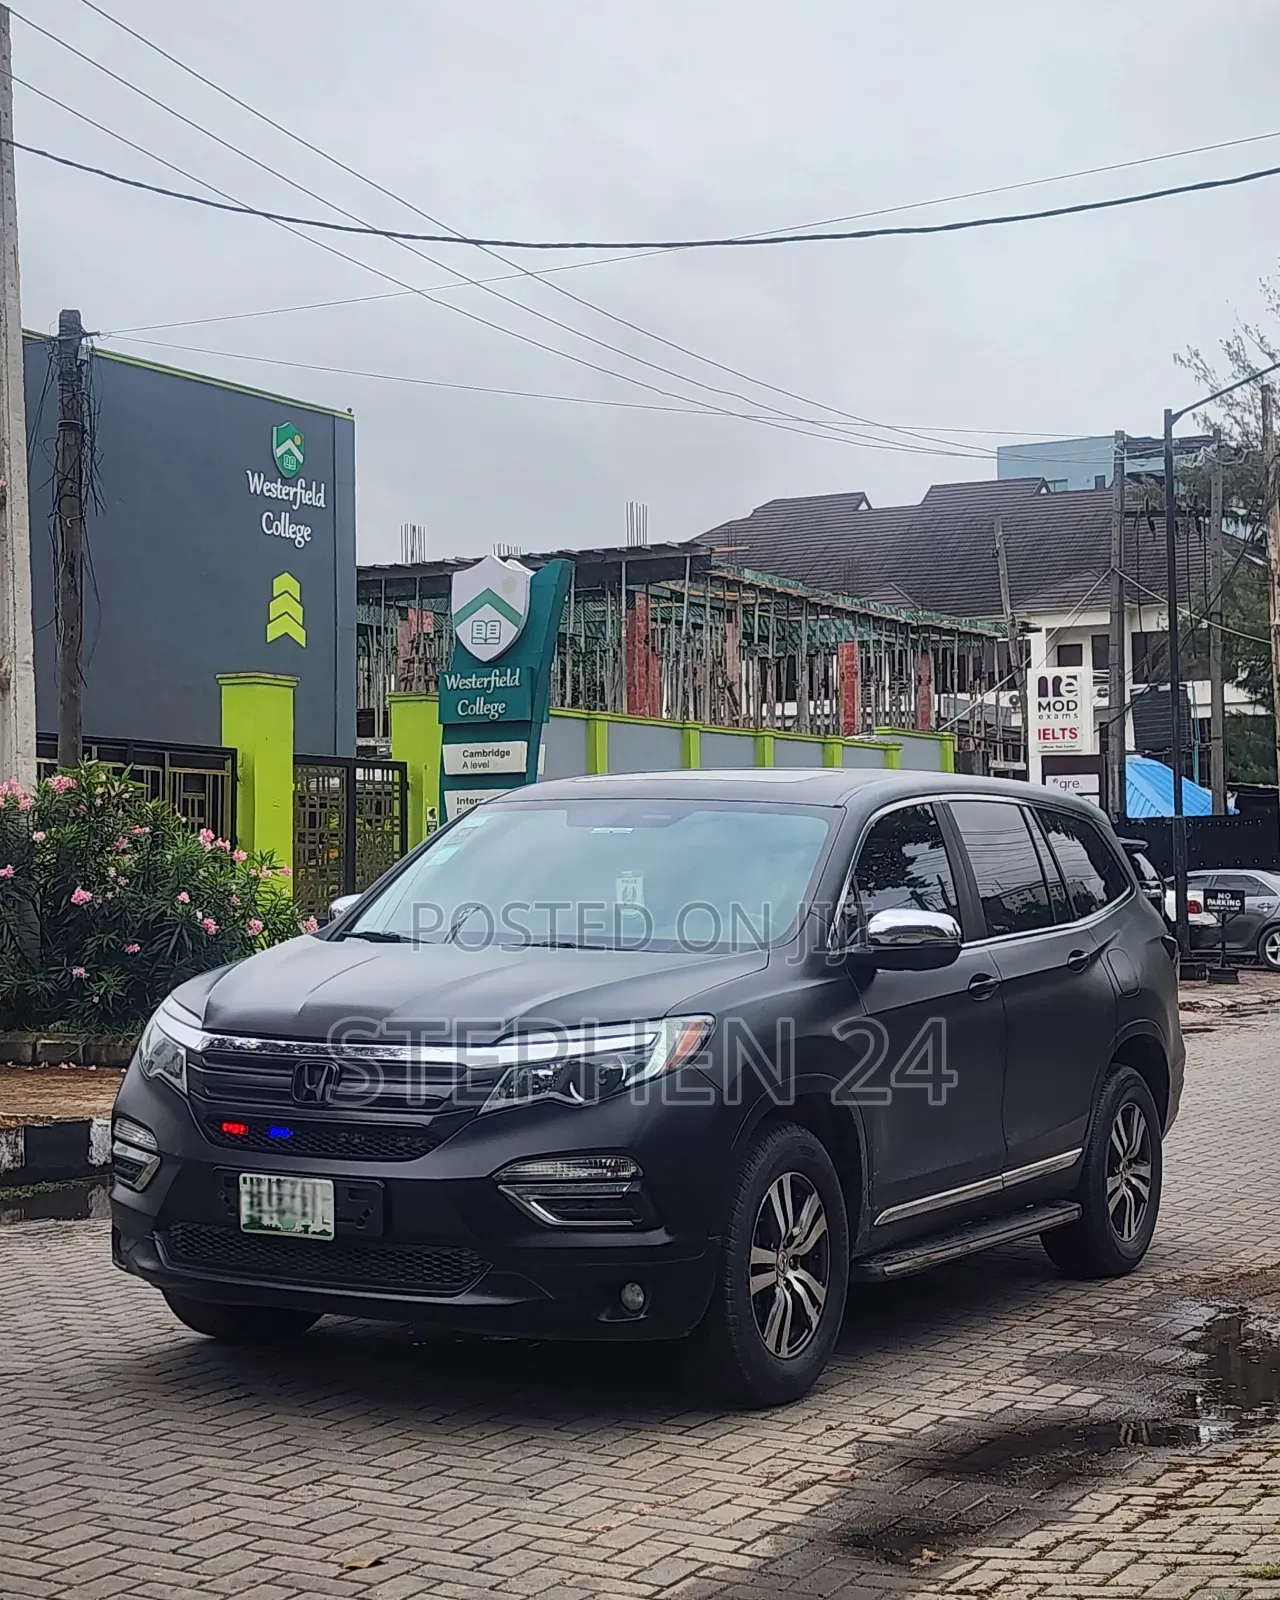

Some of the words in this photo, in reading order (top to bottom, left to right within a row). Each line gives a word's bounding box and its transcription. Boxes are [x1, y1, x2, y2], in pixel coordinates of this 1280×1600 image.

[246, 469, 326, 510] Westerfield
[261, 511, 312, 548] College
[444, 667, 520, 694] Westerfield
[457, 696, 506, 720] College
[1038, 700, 1078, 713] MOD
[1037, 727, 1078, 741] IELTS
[462, 748, 511, 759] Cambridge
[461, 761, 469, 770] A
[470, 760, 490, 769] level
